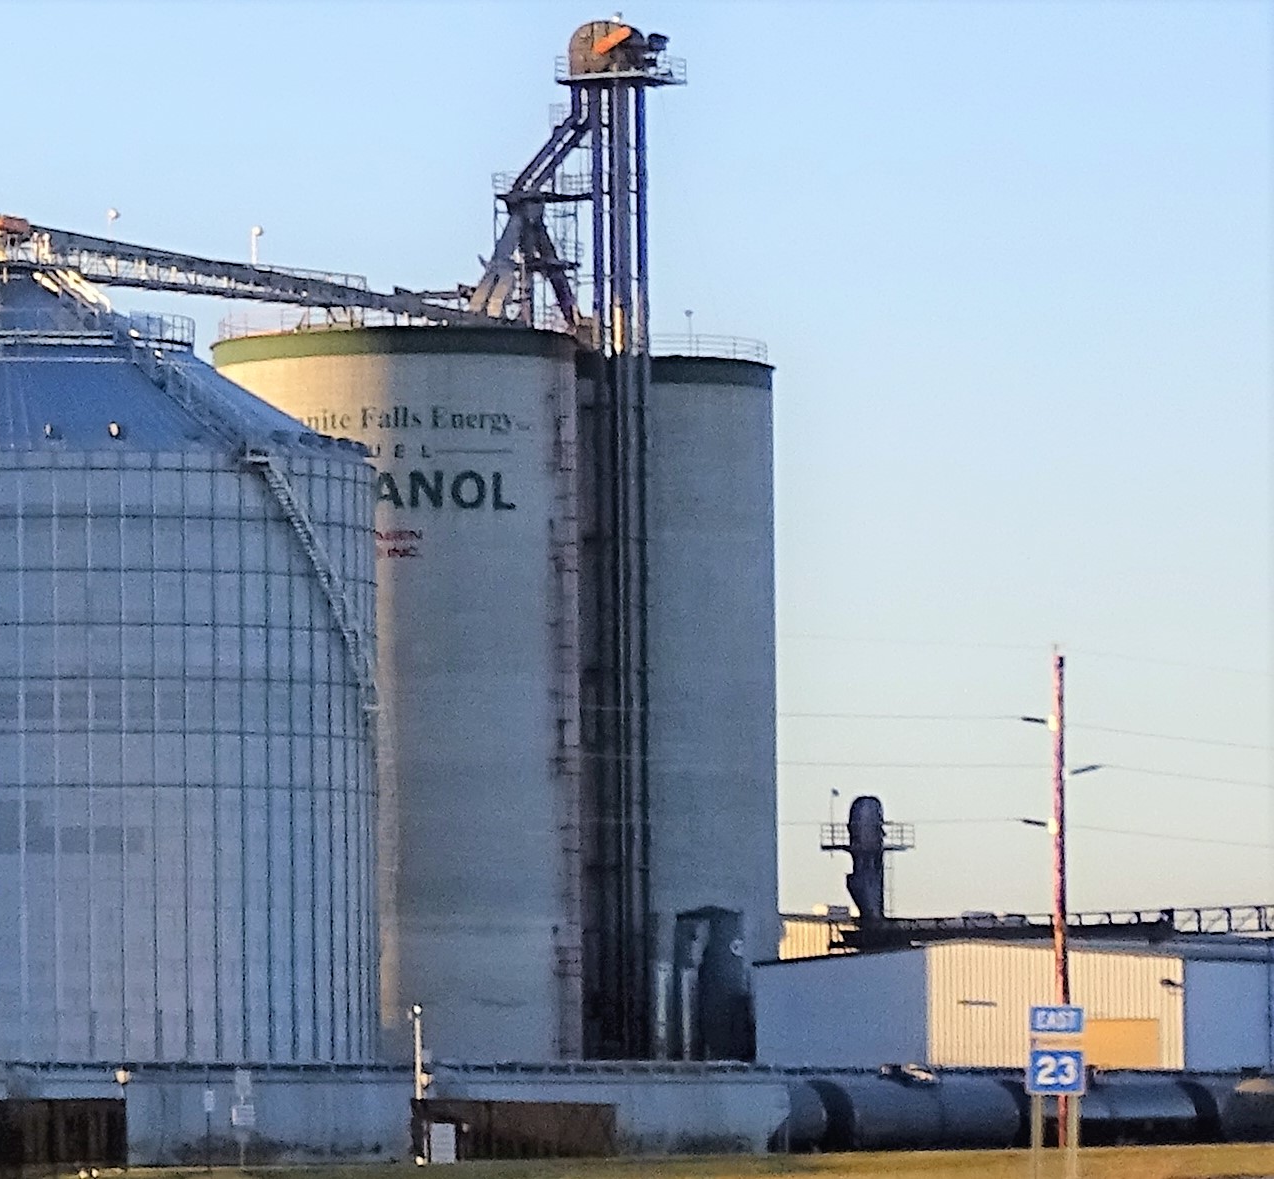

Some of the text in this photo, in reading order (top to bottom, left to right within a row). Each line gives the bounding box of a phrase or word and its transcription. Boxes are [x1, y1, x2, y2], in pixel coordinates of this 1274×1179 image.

[301, 408, 351, 431] nite
[361, 406, 422, 430] Falls
[431, 406, 513, 435] Energy
[1036, 1010, 1076, 1030] EAST
[1035, 1055, 1079, 1086] 23
